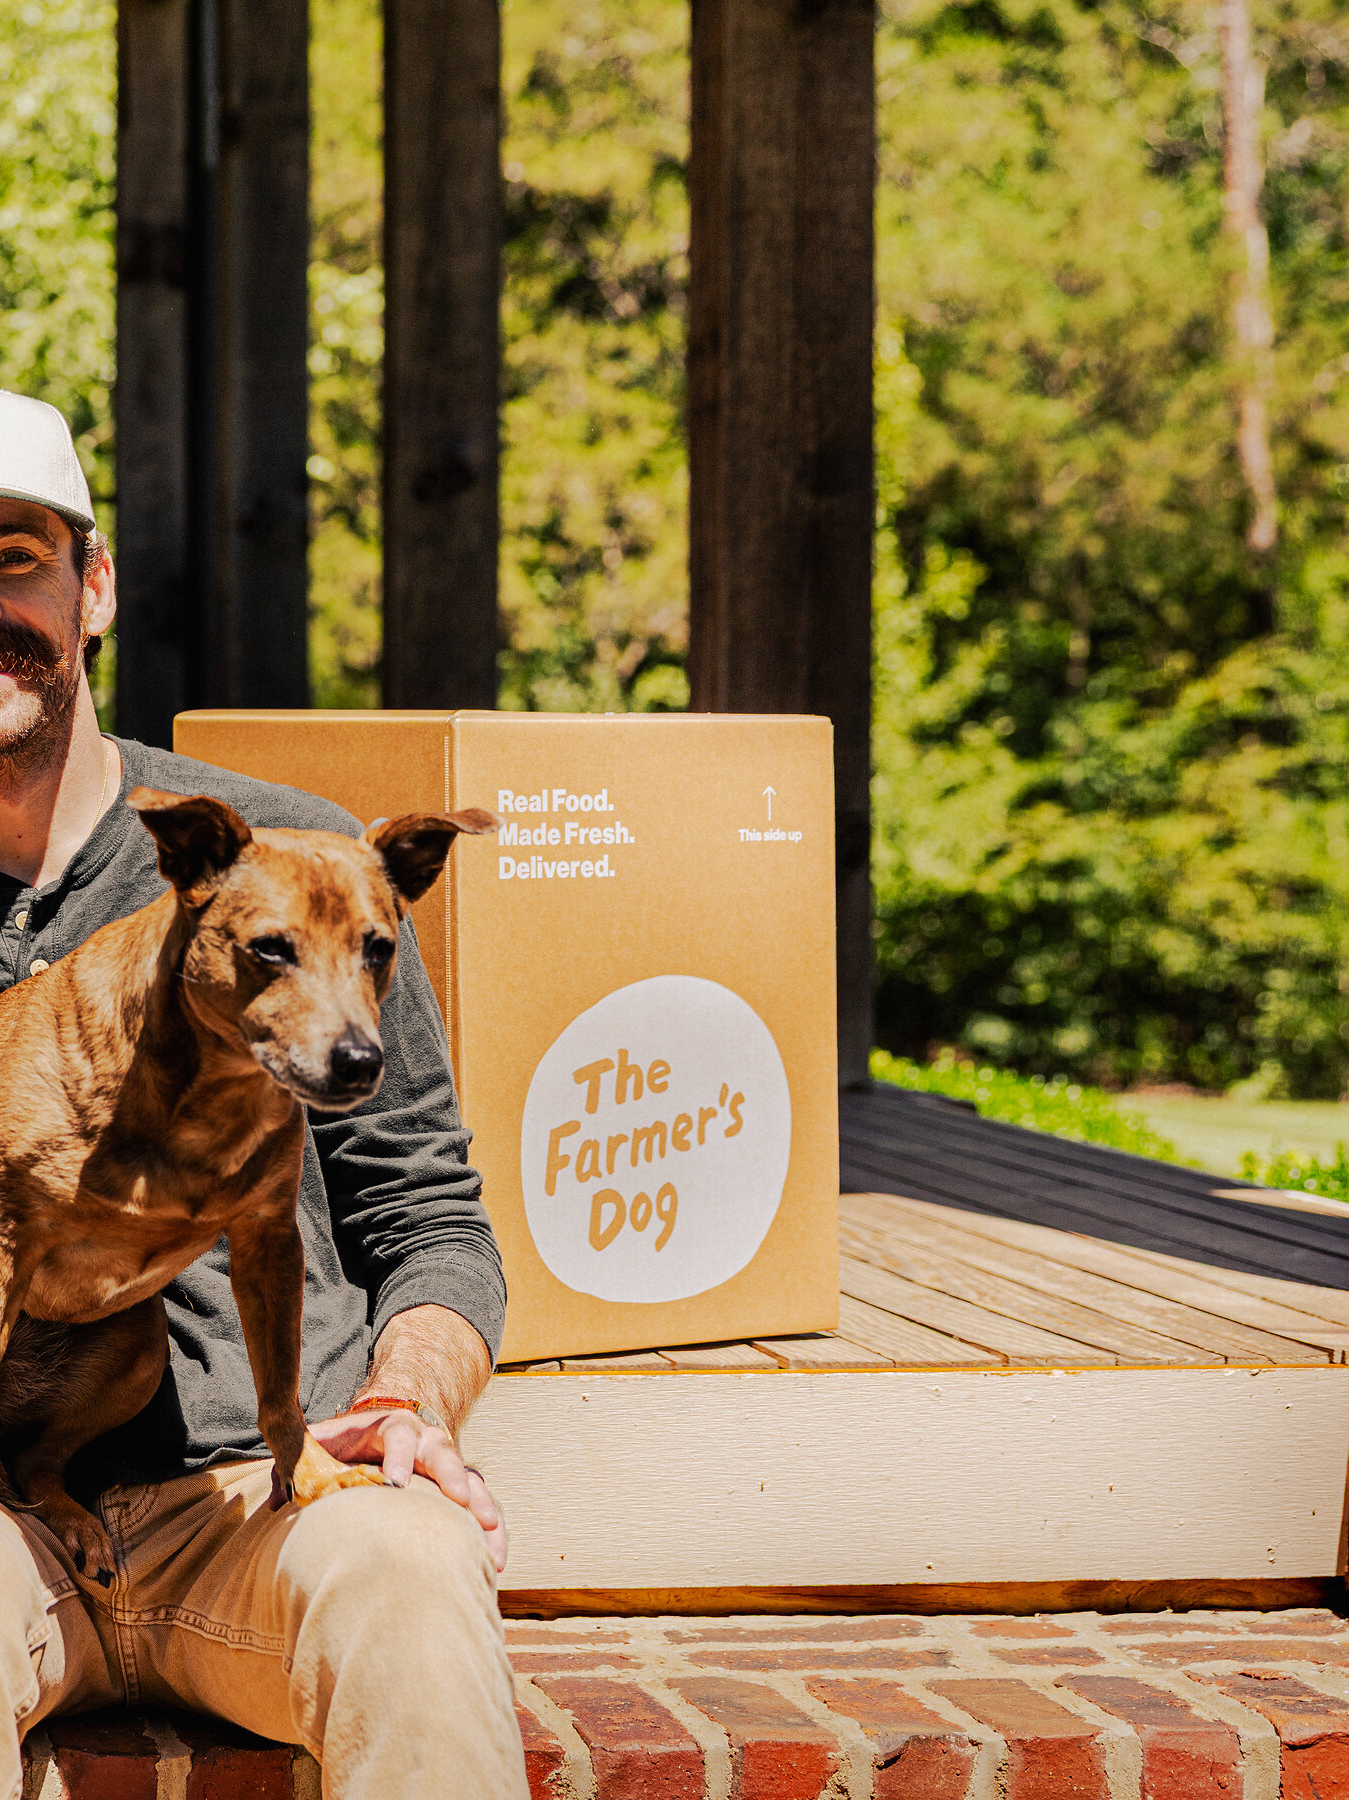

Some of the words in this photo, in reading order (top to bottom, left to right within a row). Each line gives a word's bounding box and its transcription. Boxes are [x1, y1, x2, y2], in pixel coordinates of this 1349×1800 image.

[498, 789, 548, 812] Real
[551, 788, 614, 812] Food.
[498, 822, 561, 846] Made
[564, 821, 635, 845] Fresh.
[737, 828, 762, 842] This
[763, 828, 787, 841] side
[788, 830, 803, 844] up
[498, 855, 616, 880] Delivered.
[572, 1048, 672, 1115] The
[544, 1082, 746, 1197] Farmer's
[588, 1182, 679, 1252] Dog
